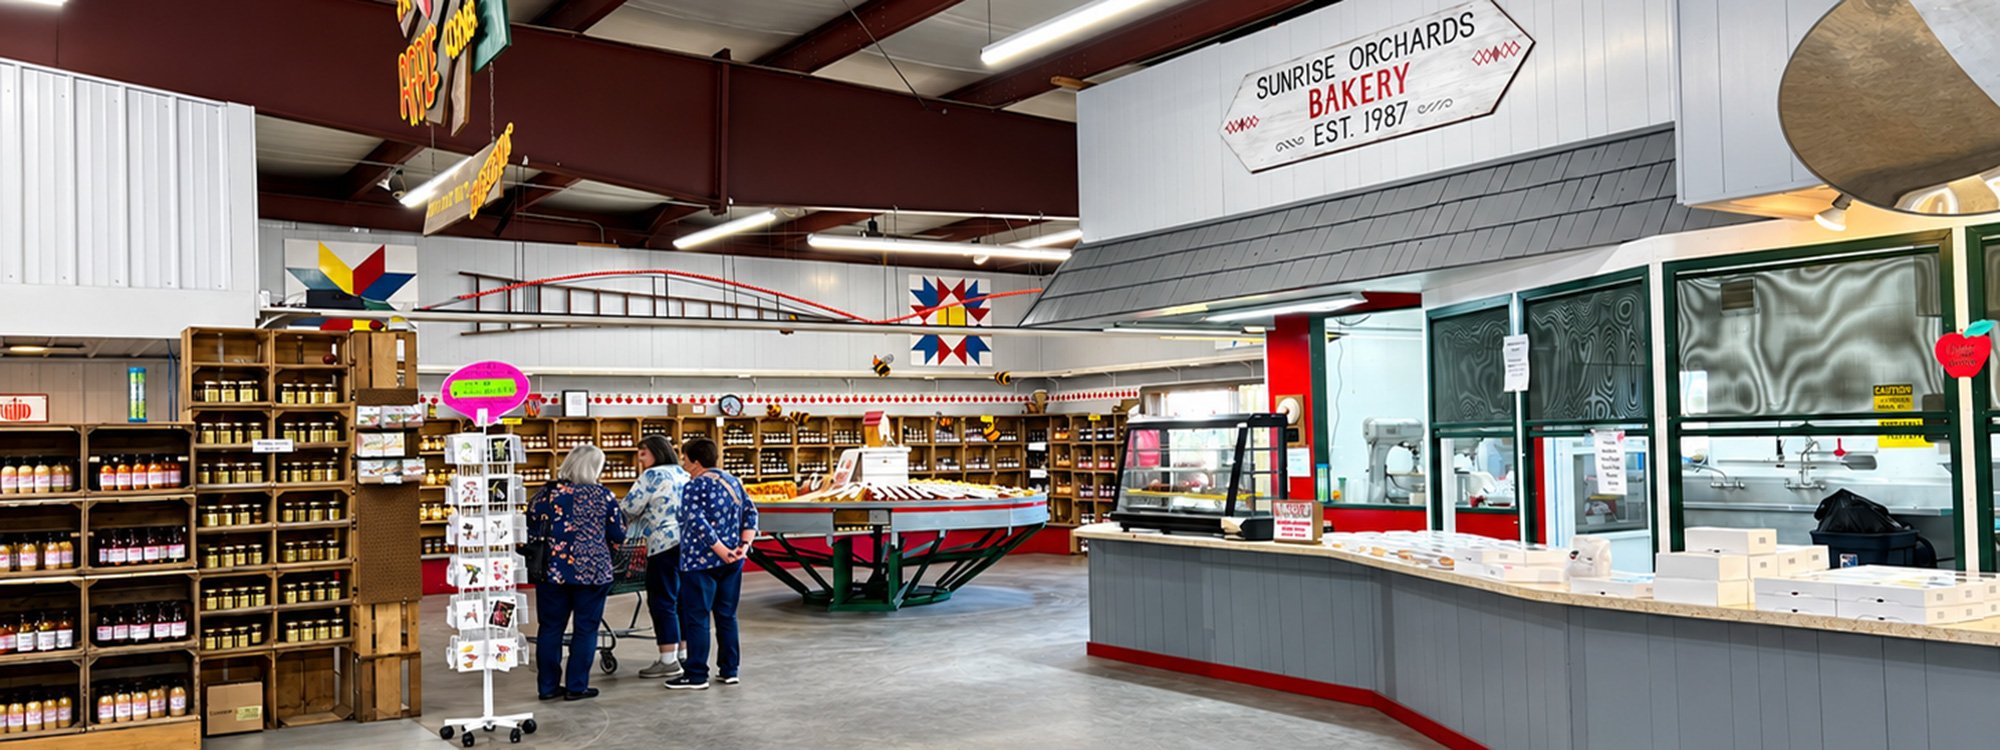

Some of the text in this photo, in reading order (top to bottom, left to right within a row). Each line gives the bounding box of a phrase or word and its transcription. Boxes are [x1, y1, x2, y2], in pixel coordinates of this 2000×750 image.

[398, 22, 439, 127] APPLE
[1256, 11, 1476, 100] SUNRISE ORCHARDS
[1308, 61, 1410, 120] BAKERY
[1313, 101, 1409, 148] EST. 1987
[1874, 385, 1912, 395] CAUTION
